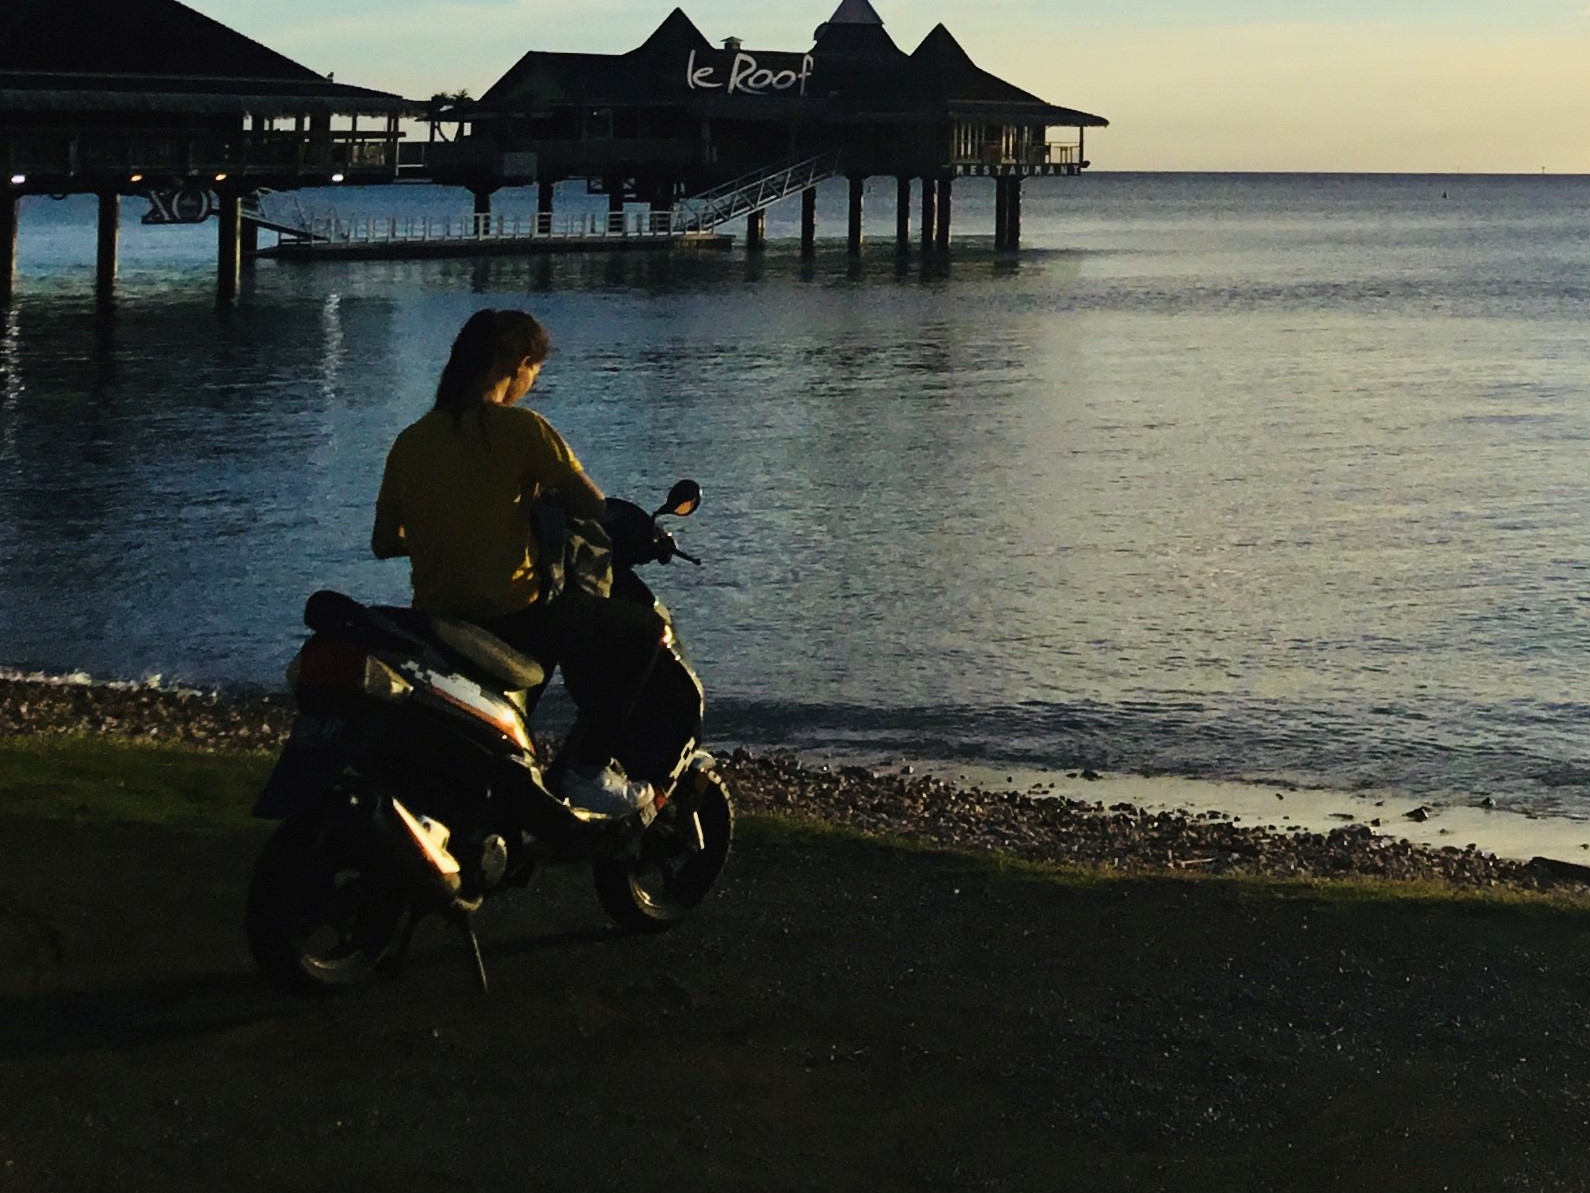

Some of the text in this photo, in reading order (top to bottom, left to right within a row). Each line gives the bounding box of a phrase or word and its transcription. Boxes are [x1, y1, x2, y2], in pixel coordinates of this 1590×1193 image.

[686, 49, 814, 96] le Roof
[956, 164, 1080, 176] RESTAURANT
